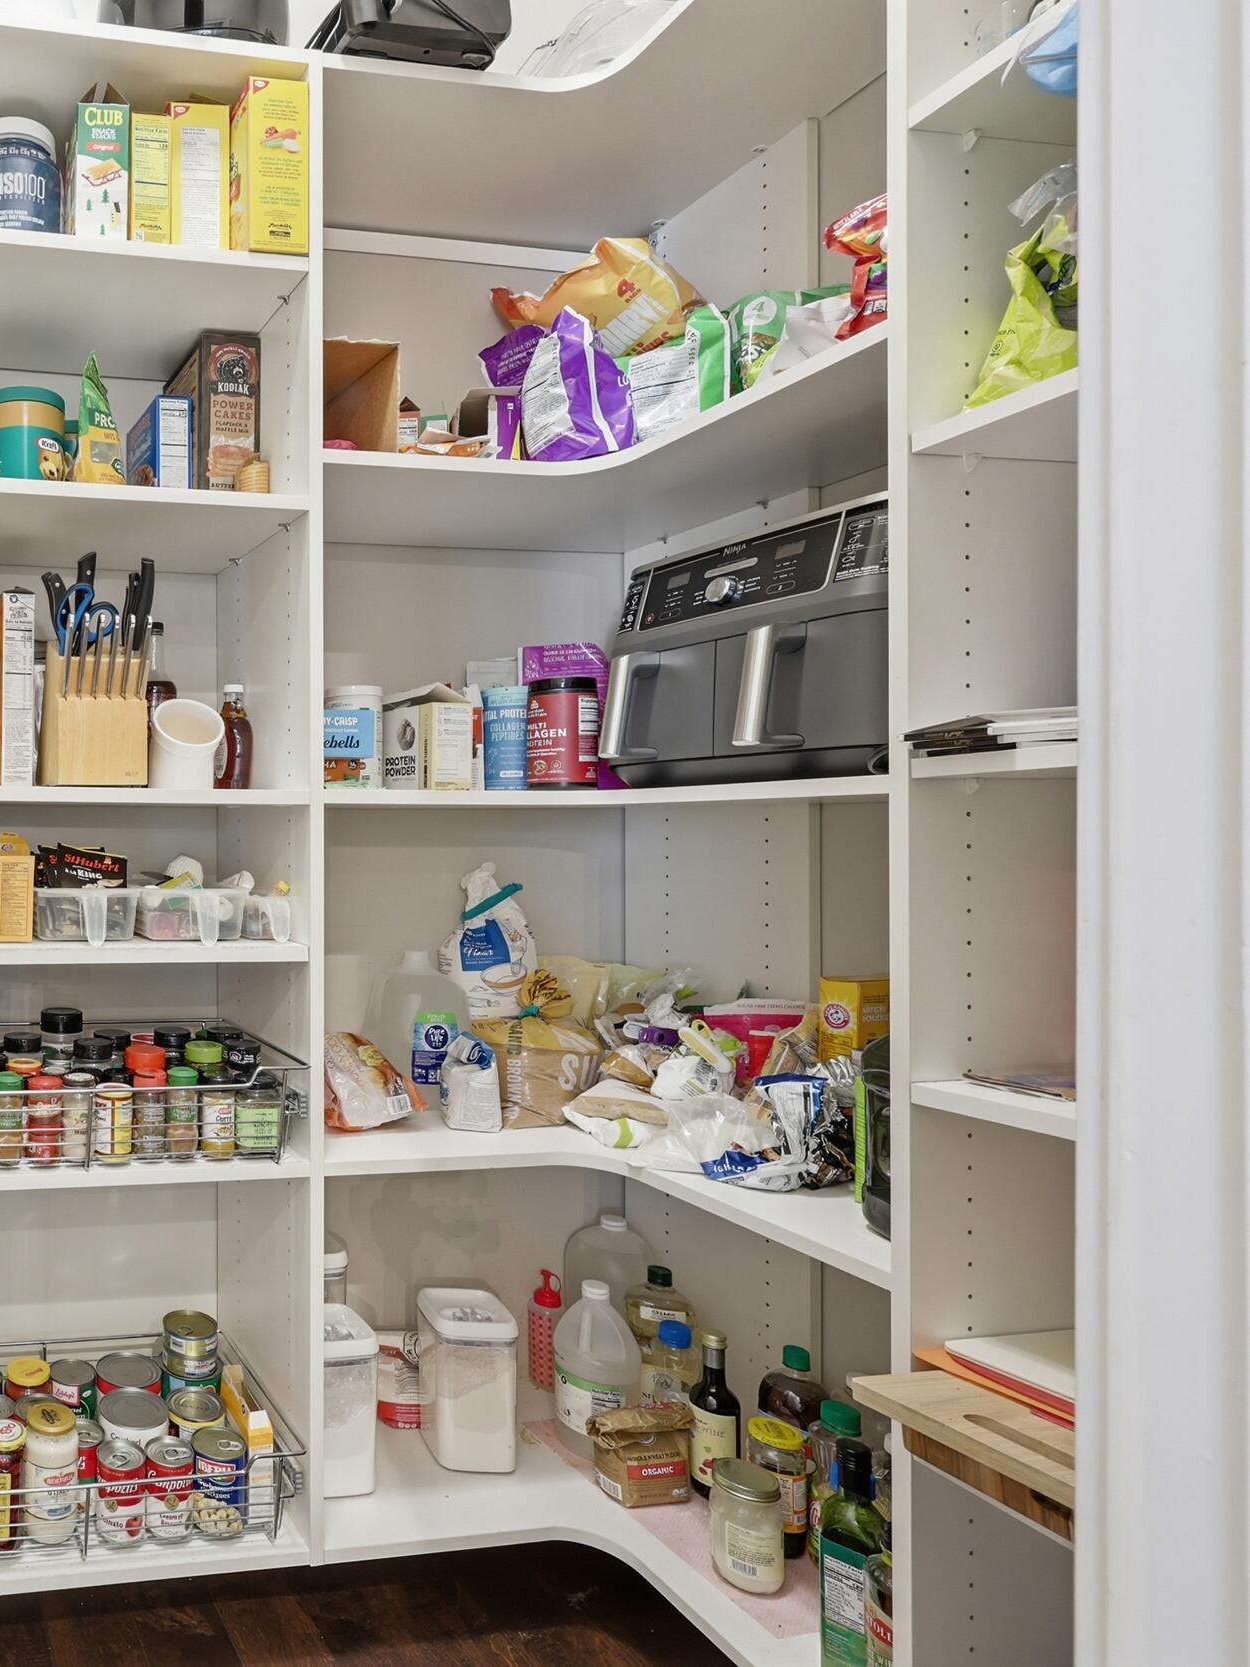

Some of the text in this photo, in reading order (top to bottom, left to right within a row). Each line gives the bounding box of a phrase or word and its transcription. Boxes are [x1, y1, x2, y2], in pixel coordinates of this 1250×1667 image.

[84, 106, 124, 127] CLUB
[616, 278, 635, 298] 4
[217, 382, 250, 396] KODIAK
[212, 400, 254, 411] POWER
[214, 409, 251, 421] CAKES
[40, 439, 59, 452] Kraft
[500, 708, 527, 718] PROTEI
[490, 722, 526, 732] COLLAGEN
[491, 731, 526, 742] PEPTIDES
[385, 756, 416, 767] PROTEIN
[385, 766, 416, 777] POWDER
[77, 868, 103, 880] KING
[428, 1027, 447, 1038] Pure
[506, 1021, 522, 1103] GANIC BROWN
[641, 1466, 675, 1477] ORGANIC
